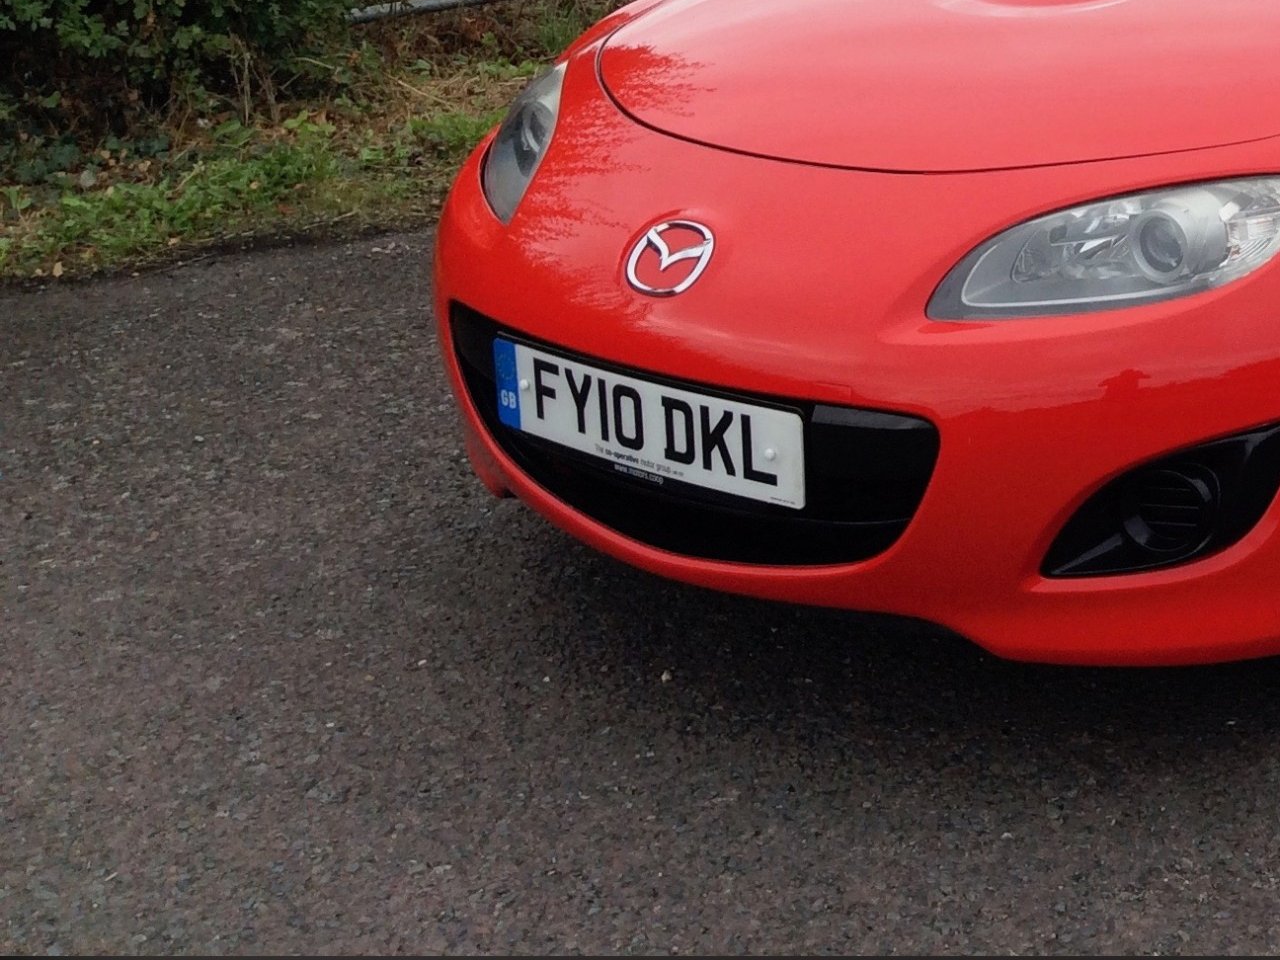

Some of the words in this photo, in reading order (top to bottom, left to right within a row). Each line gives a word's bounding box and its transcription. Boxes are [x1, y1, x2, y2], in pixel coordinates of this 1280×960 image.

[501, 390, 516, 409] GB
[533, 357, 644, 451] FY10
[661, 395, 777, 487] DKL
